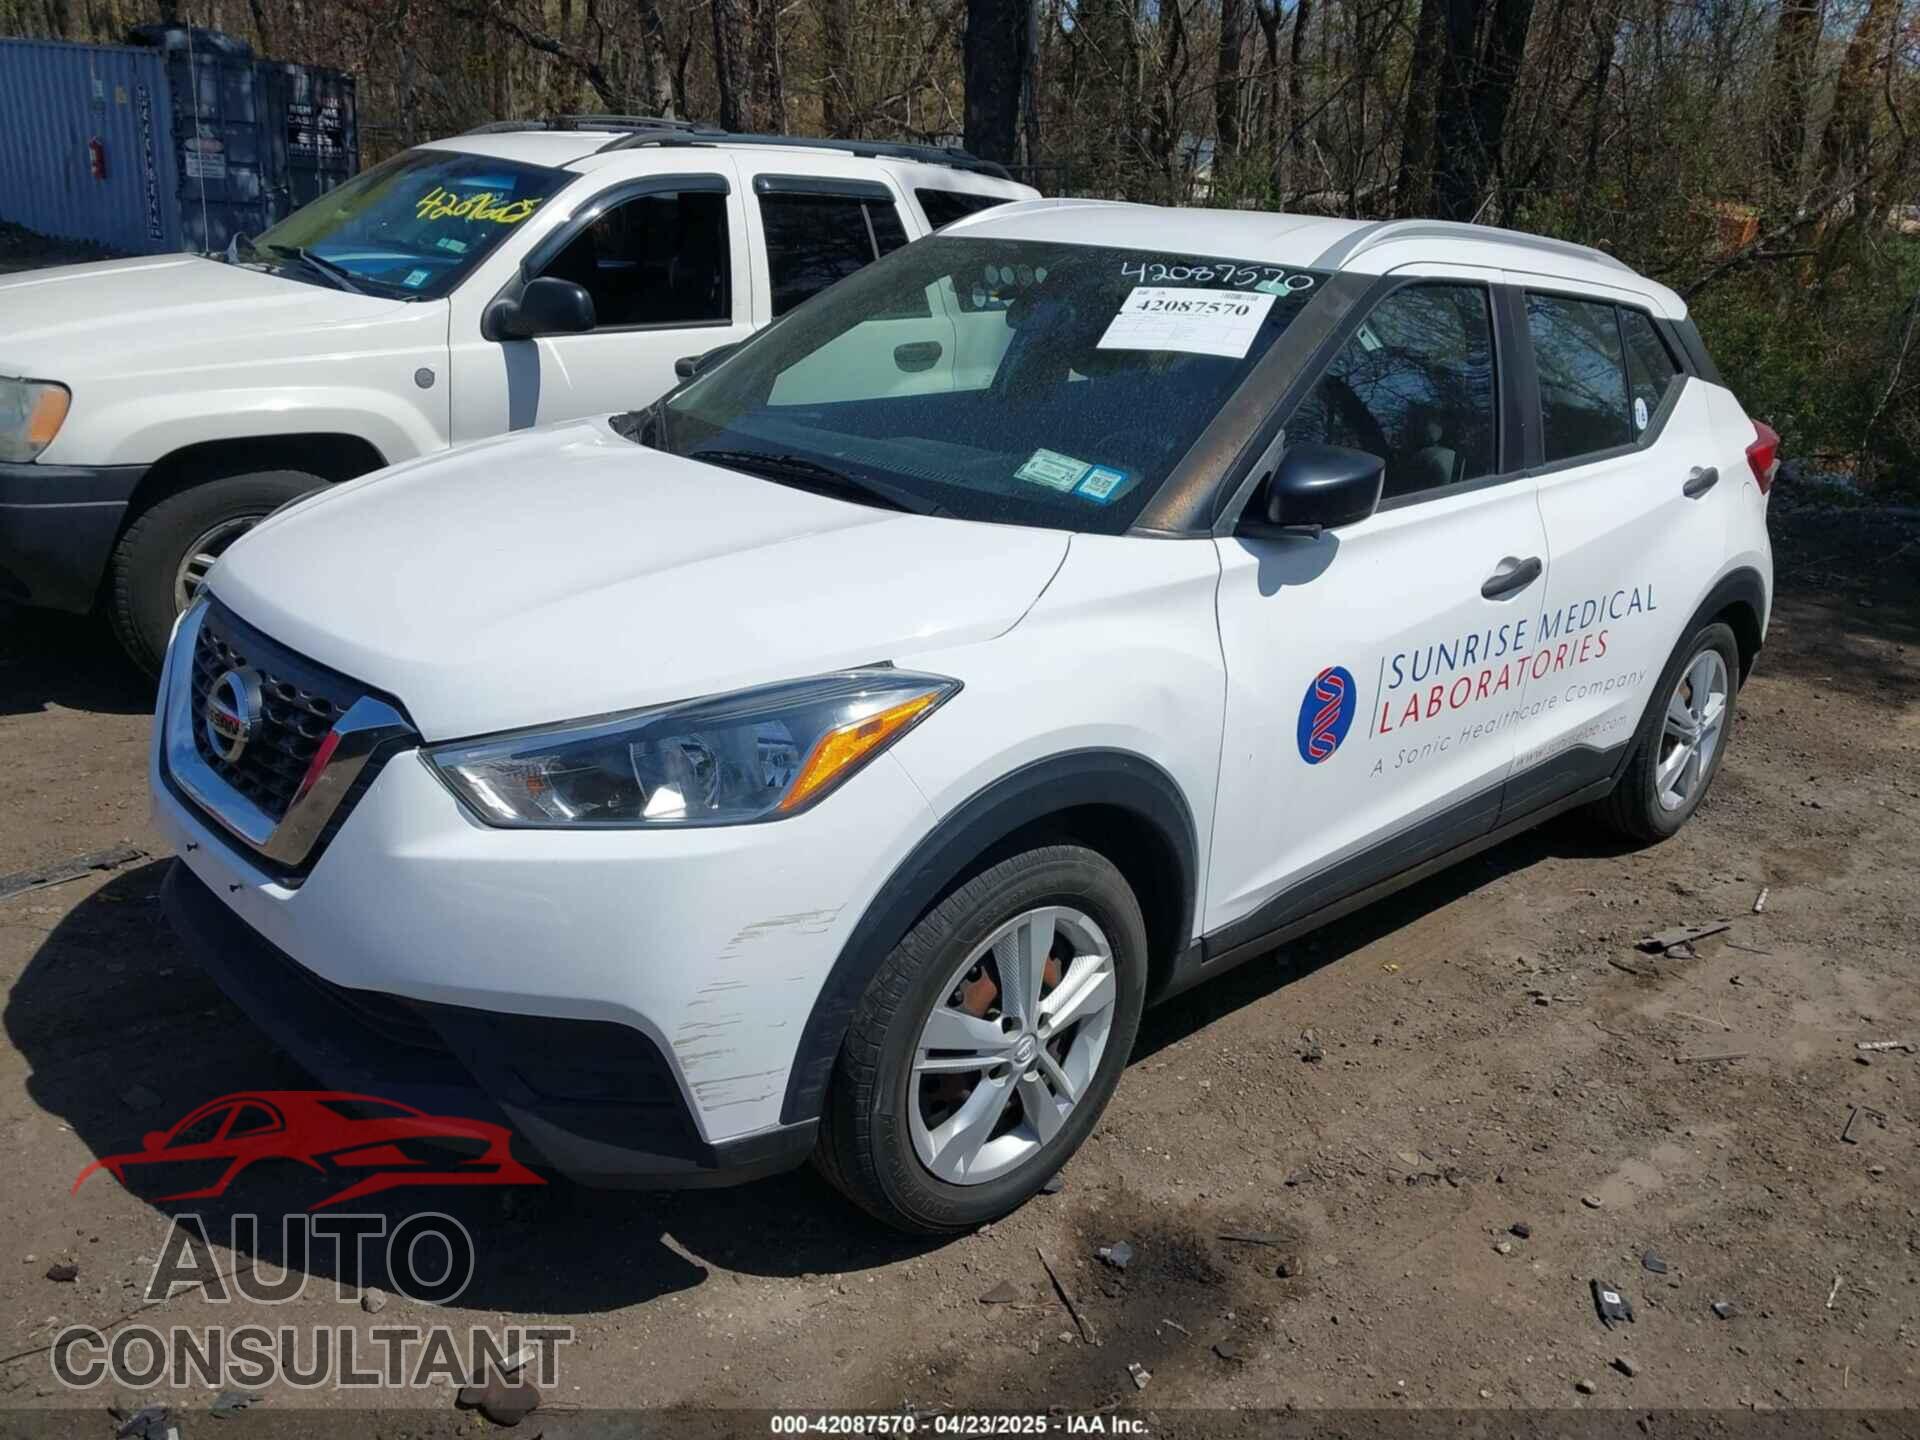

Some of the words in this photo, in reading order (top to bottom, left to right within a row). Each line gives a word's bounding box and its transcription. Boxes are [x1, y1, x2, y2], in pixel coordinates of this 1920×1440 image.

[1120, 261, 1315, 290] 42087570
[1136, 300, 1250, 317] 42087570
[1379, 629, 1609, 735] LABORATORIES
[1388, 619, 1527, 690] SUNRISE
[1537, 583, 1657, 643] MEDICAL
[1369, 759, 1383, 778] A
[1394, 736, 1451, 769] Sonic
[1458, 695, 1557, 745] Healthcare
[1565, 667, 1646, 702] Company
